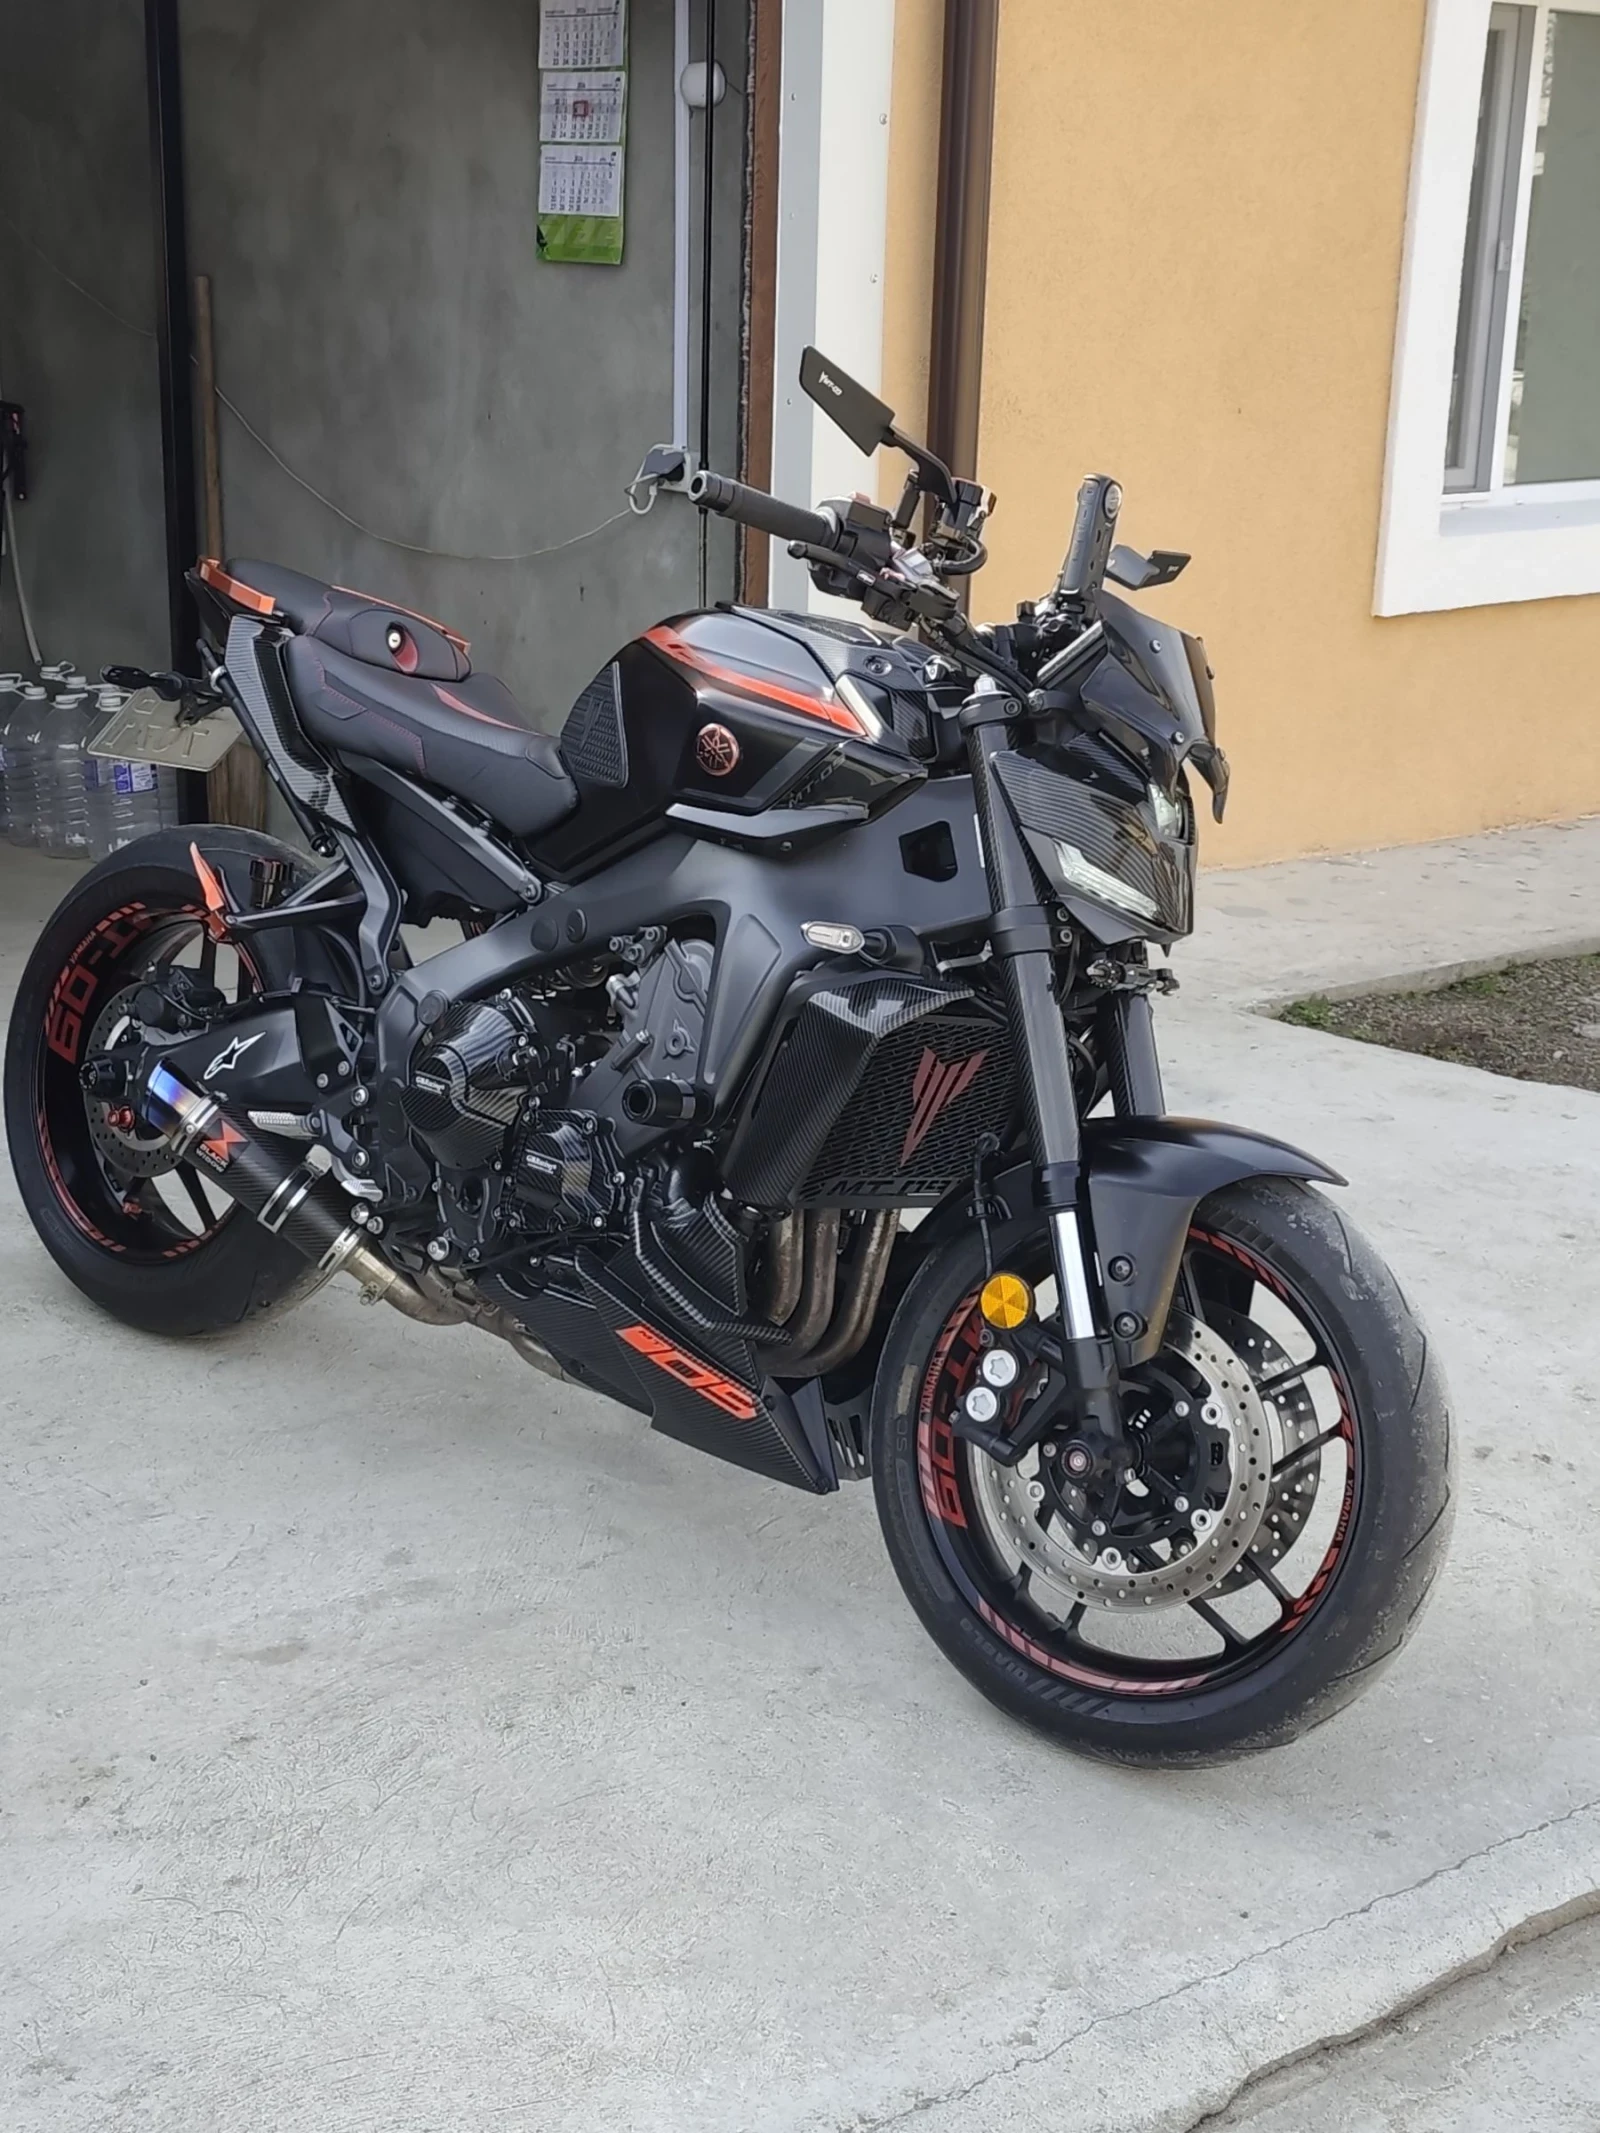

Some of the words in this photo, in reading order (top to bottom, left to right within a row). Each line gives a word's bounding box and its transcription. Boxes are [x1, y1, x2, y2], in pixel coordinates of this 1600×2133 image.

[196, 1148, 225, 1173] WIDOW
[200, 1143, 229, 1168] BLACK
[919, 1356, 946, 1414] YAMAHA
[1335, 1479, 1354, 1542] YAMAHA
